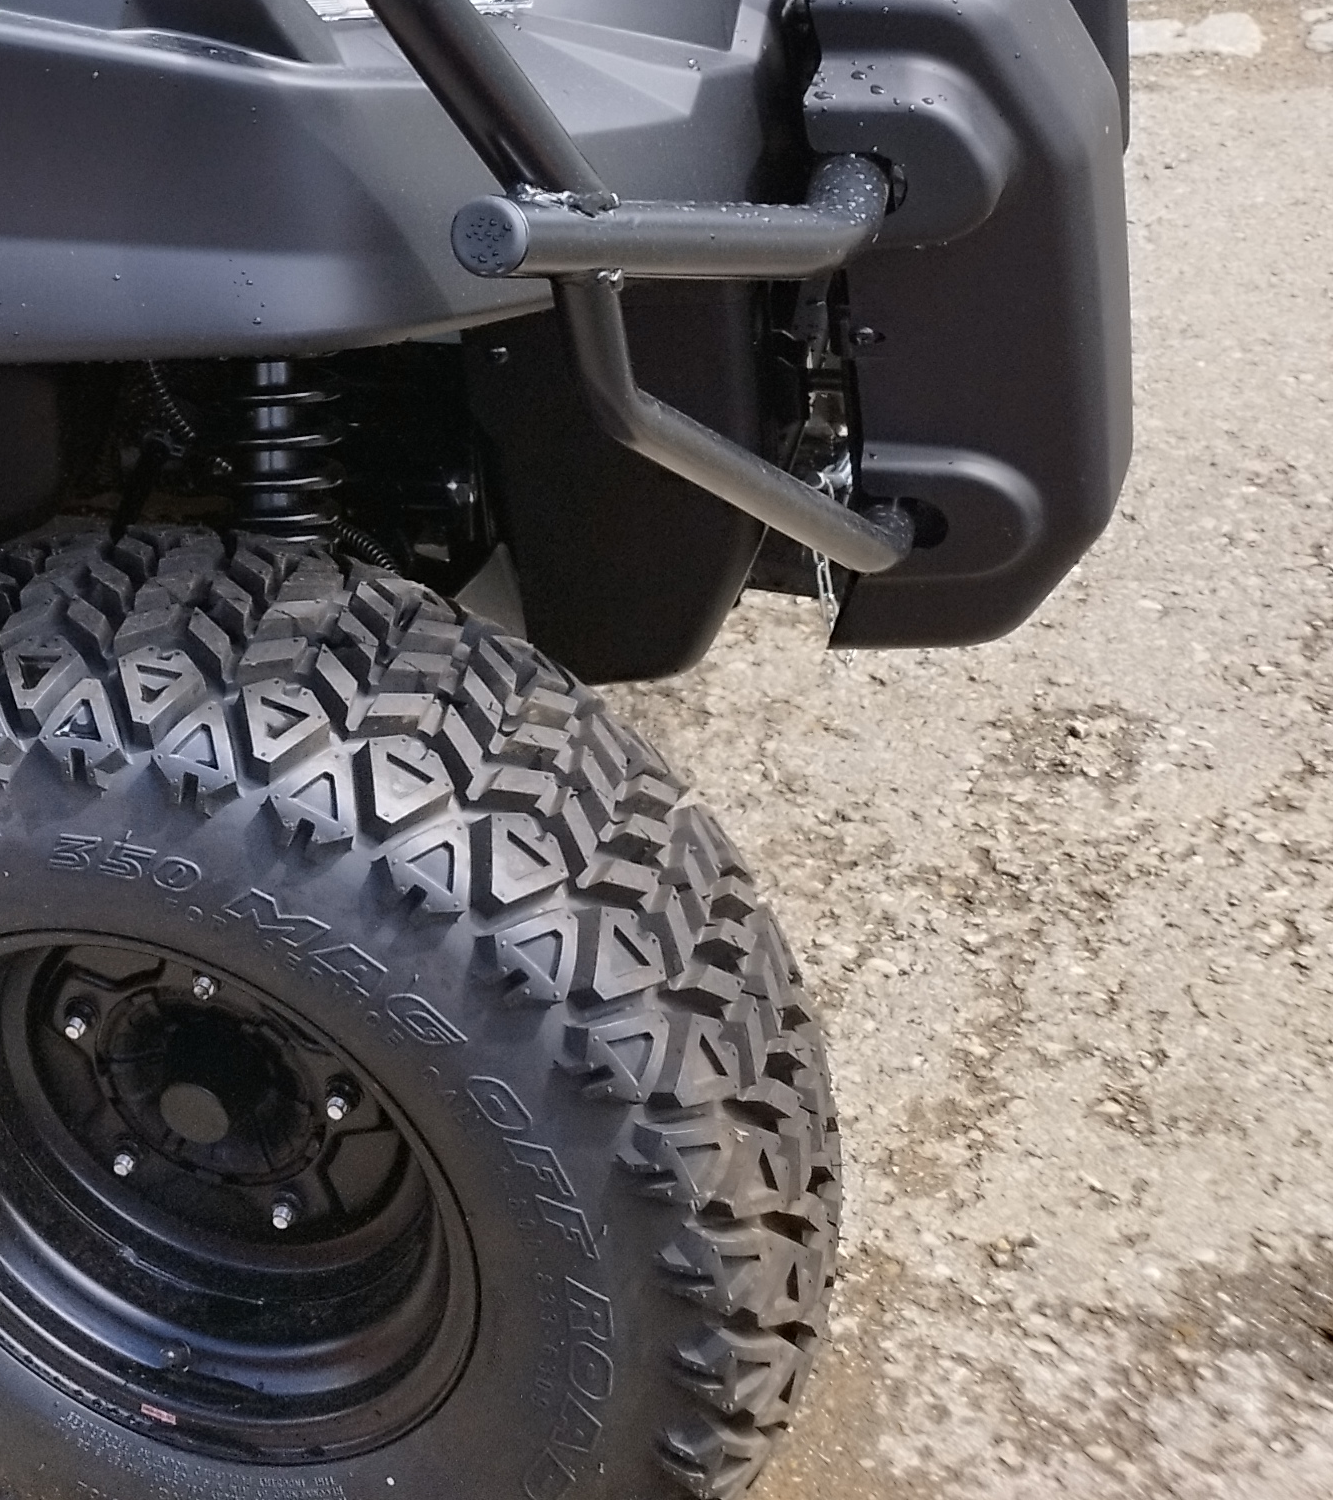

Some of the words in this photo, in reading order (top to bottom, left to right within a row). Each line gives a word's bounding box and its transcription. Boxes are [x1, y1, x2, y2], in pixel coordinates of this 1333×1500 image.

[48, 832, 203, 892] 350
[220, 887, 470, 1045] MAG
[466, 1075, 601, 1261] OFF
